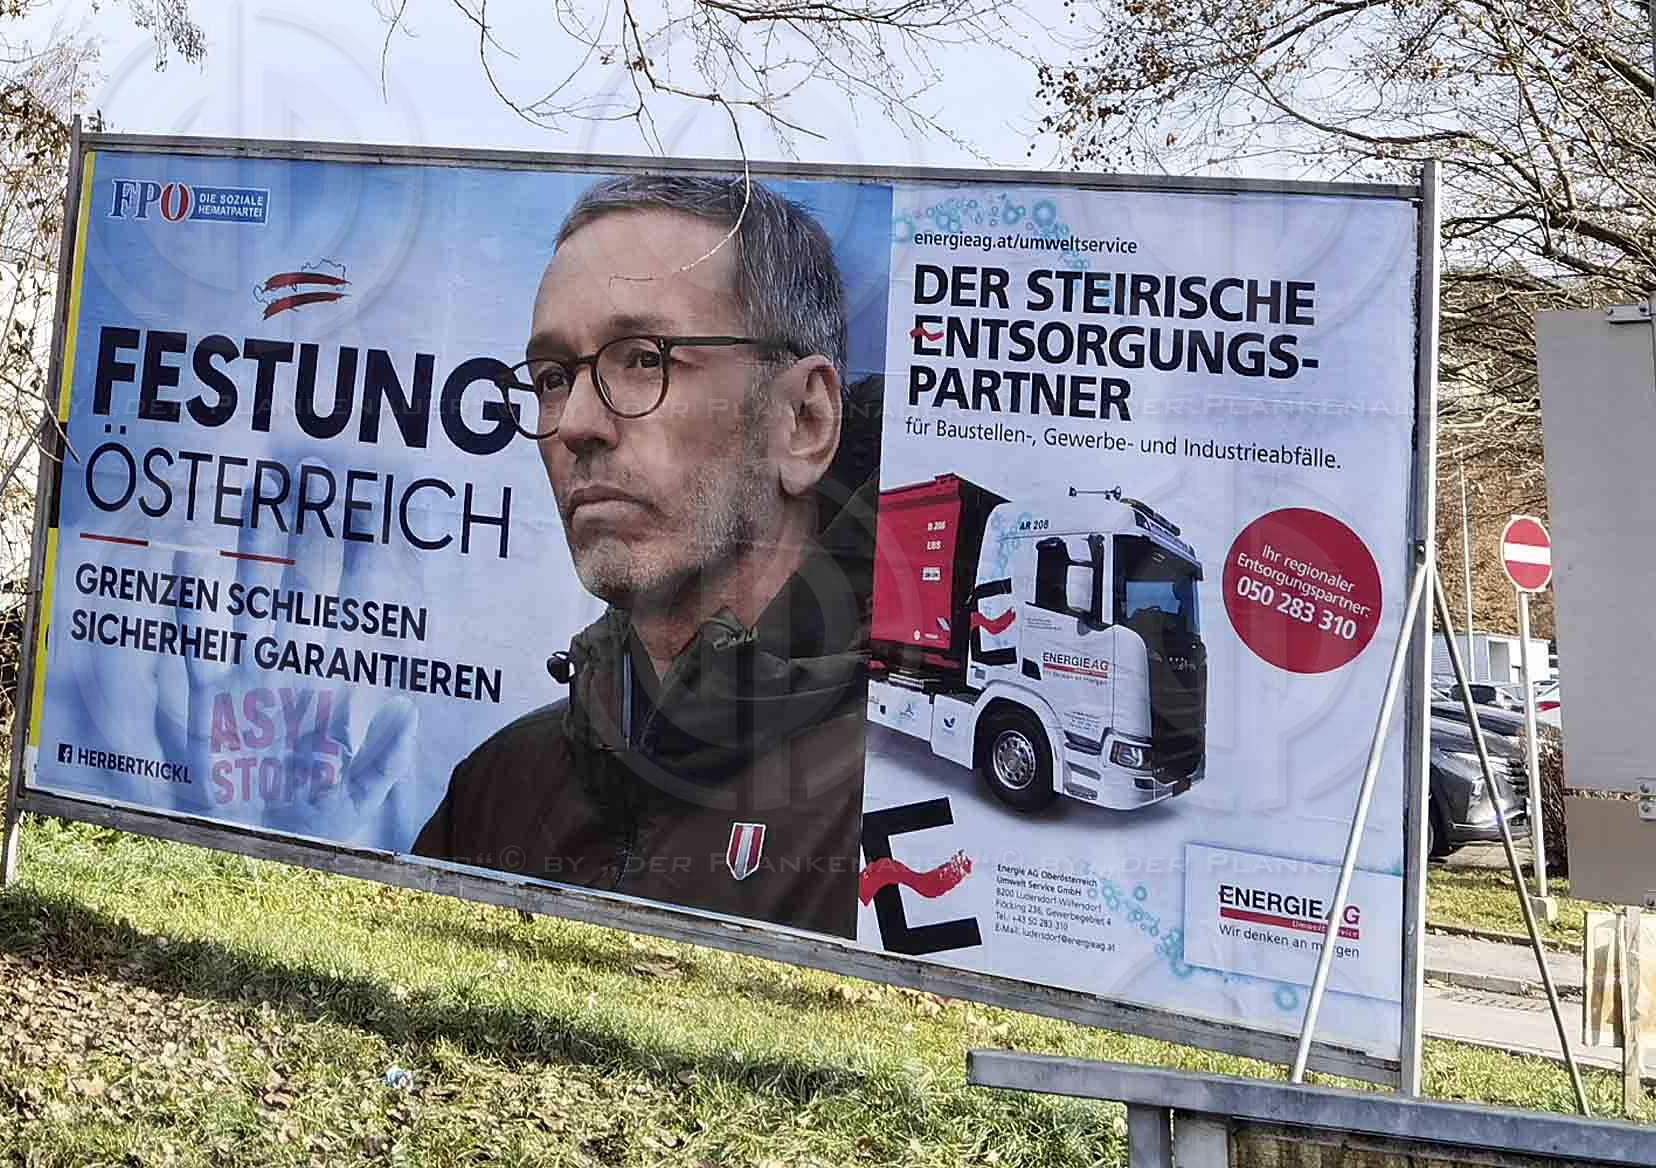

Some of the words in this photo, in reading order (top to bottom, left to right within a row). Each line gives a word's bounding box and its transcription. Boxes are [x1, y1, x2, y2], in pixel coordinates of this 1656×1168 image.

[198, 205, 263, 218] HEIMATPARTEI
[199, 193, 217, 204] DIE
[220, 194, 264, 206] SOZIALE
[914, 231, 1138, 254] energieag.at/umweltservice
[913, 263, 1010, 309] DER
[1026, 269, 1315, 326] STEIRISCHE
[911, 315, 1319, 380] ENTSORGUNGS-
[92, 326, 521, 456] FESTUNG
[908, 365, 1132, 422] PARTNER
[905, 416, 931, 436] für
[936, 419, 1037, 447] Baustellen-,
[1044, 427, 1134, 451] Gewerbe-
[1140, 435, 1177, 455] und
[1183, 438, 1342, 469] Industrieabfälle.
[85, 424, 512, 559] ÖSTERREICH
[1237, 552, 1371, 618] Entsorgungspartner:
[1262, 543, 1281, 563] Ihr
[1284, 556, 1356, 593] regionaler
[75, 563, 219, 613] GRENZEN
[226, 584, 428, 641] SCHLIESSEN
[1237, 575, 1275, 606] 050
[1276, 592, 1316, 623] 283
[1318, 609, 1357, 640] 310
[71, 609, 248, 665] SICHERHEIT
[254, 636, 503, 704] GARANTIEREN
[210, 687, 341, 756] ASYL
[78, 746, 193, 784] HERBERTKICKL
[997, 863, 1025, 876] Energie
[1027, 868, 1039, 878] AG
[1219, 923, 1241, 937] Wir
[1243, 927, 1289, 947] denken
[1292, 937, 1308, 949] an
